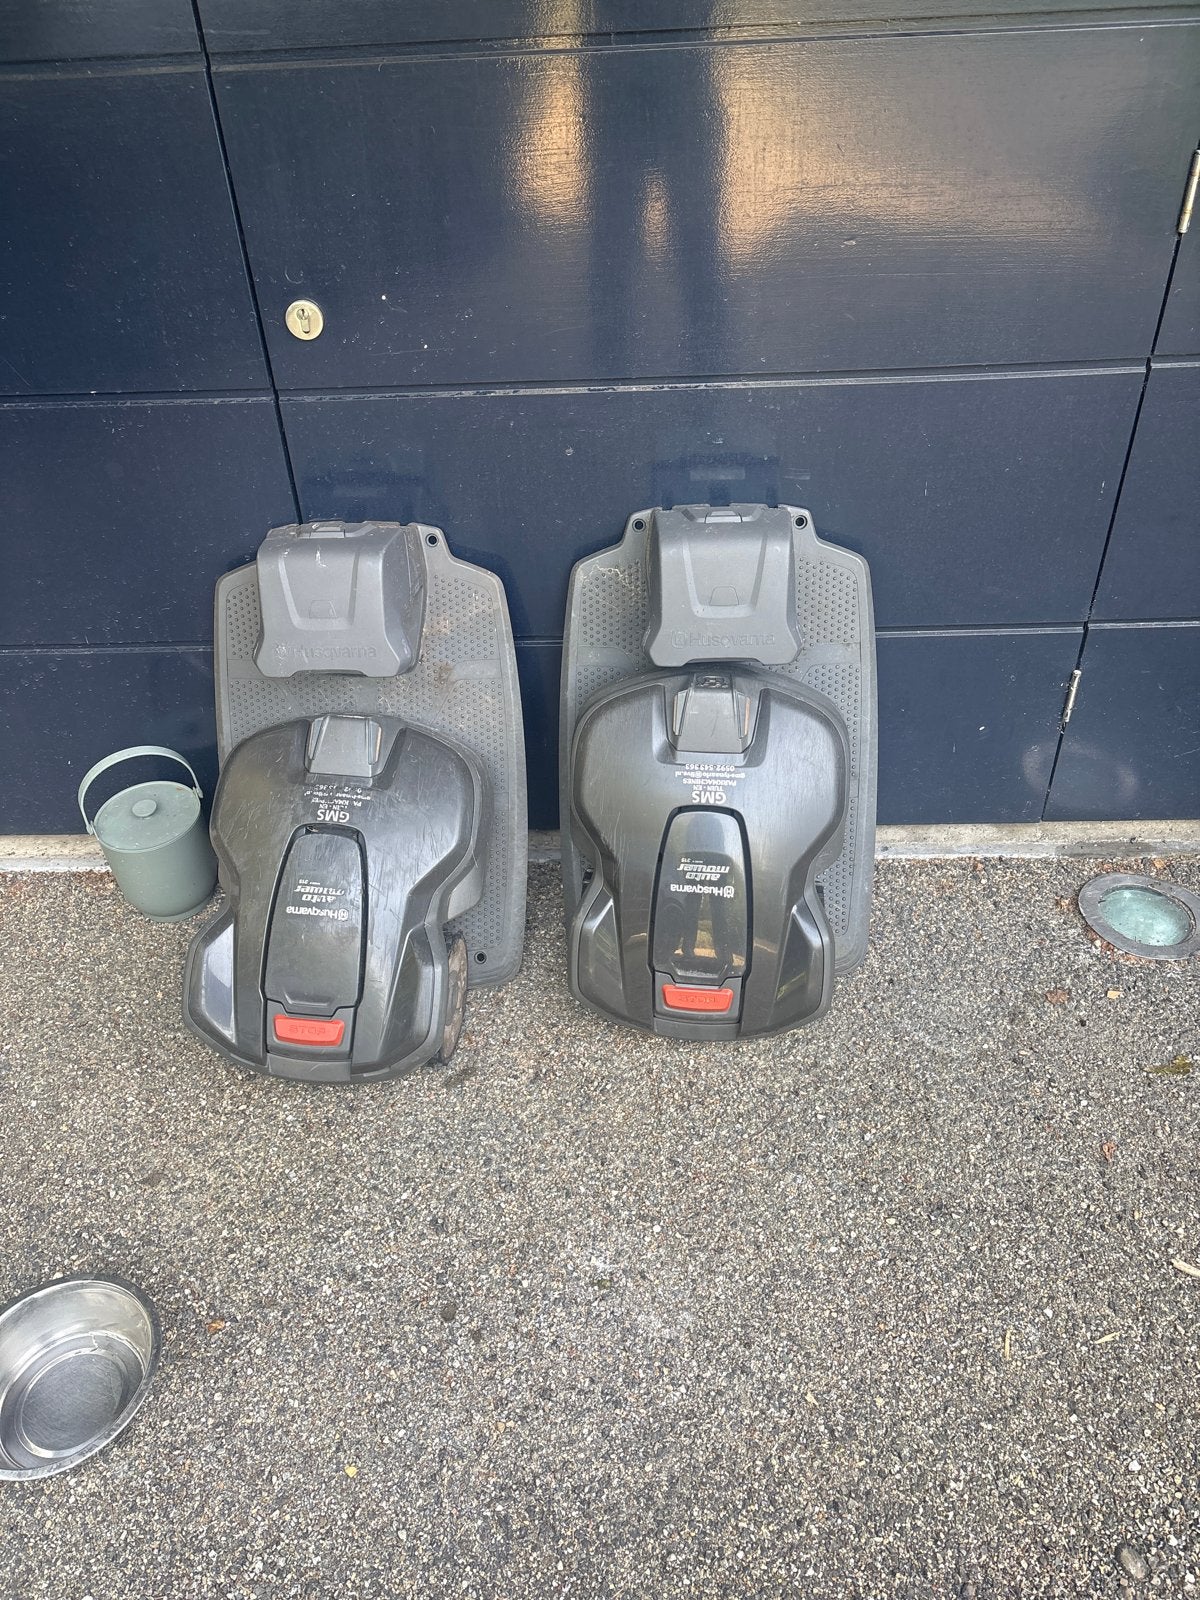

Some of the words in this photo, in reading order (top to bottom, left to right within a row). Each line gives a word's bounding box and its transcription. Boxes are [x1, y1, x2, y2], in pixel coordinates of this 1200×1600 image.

[689, 630, 775, 648] Husqvarna
[292, 644, 377, 660] Husqvarna
[682, 777, 737, 786] PARKMACHINES
[691, 790, 727, 804] GMS
[316, 809, 350, 823] GMS
[676, 863, 730, 873] mower
[685, 871, 721, 881] auto
[670, 883, 723, 897] Husqvarna
[301, 893, 337, 903] auto
[286, 905, 338, 920] Husqvarna
[288, 1024, 326, 1035] STOP
